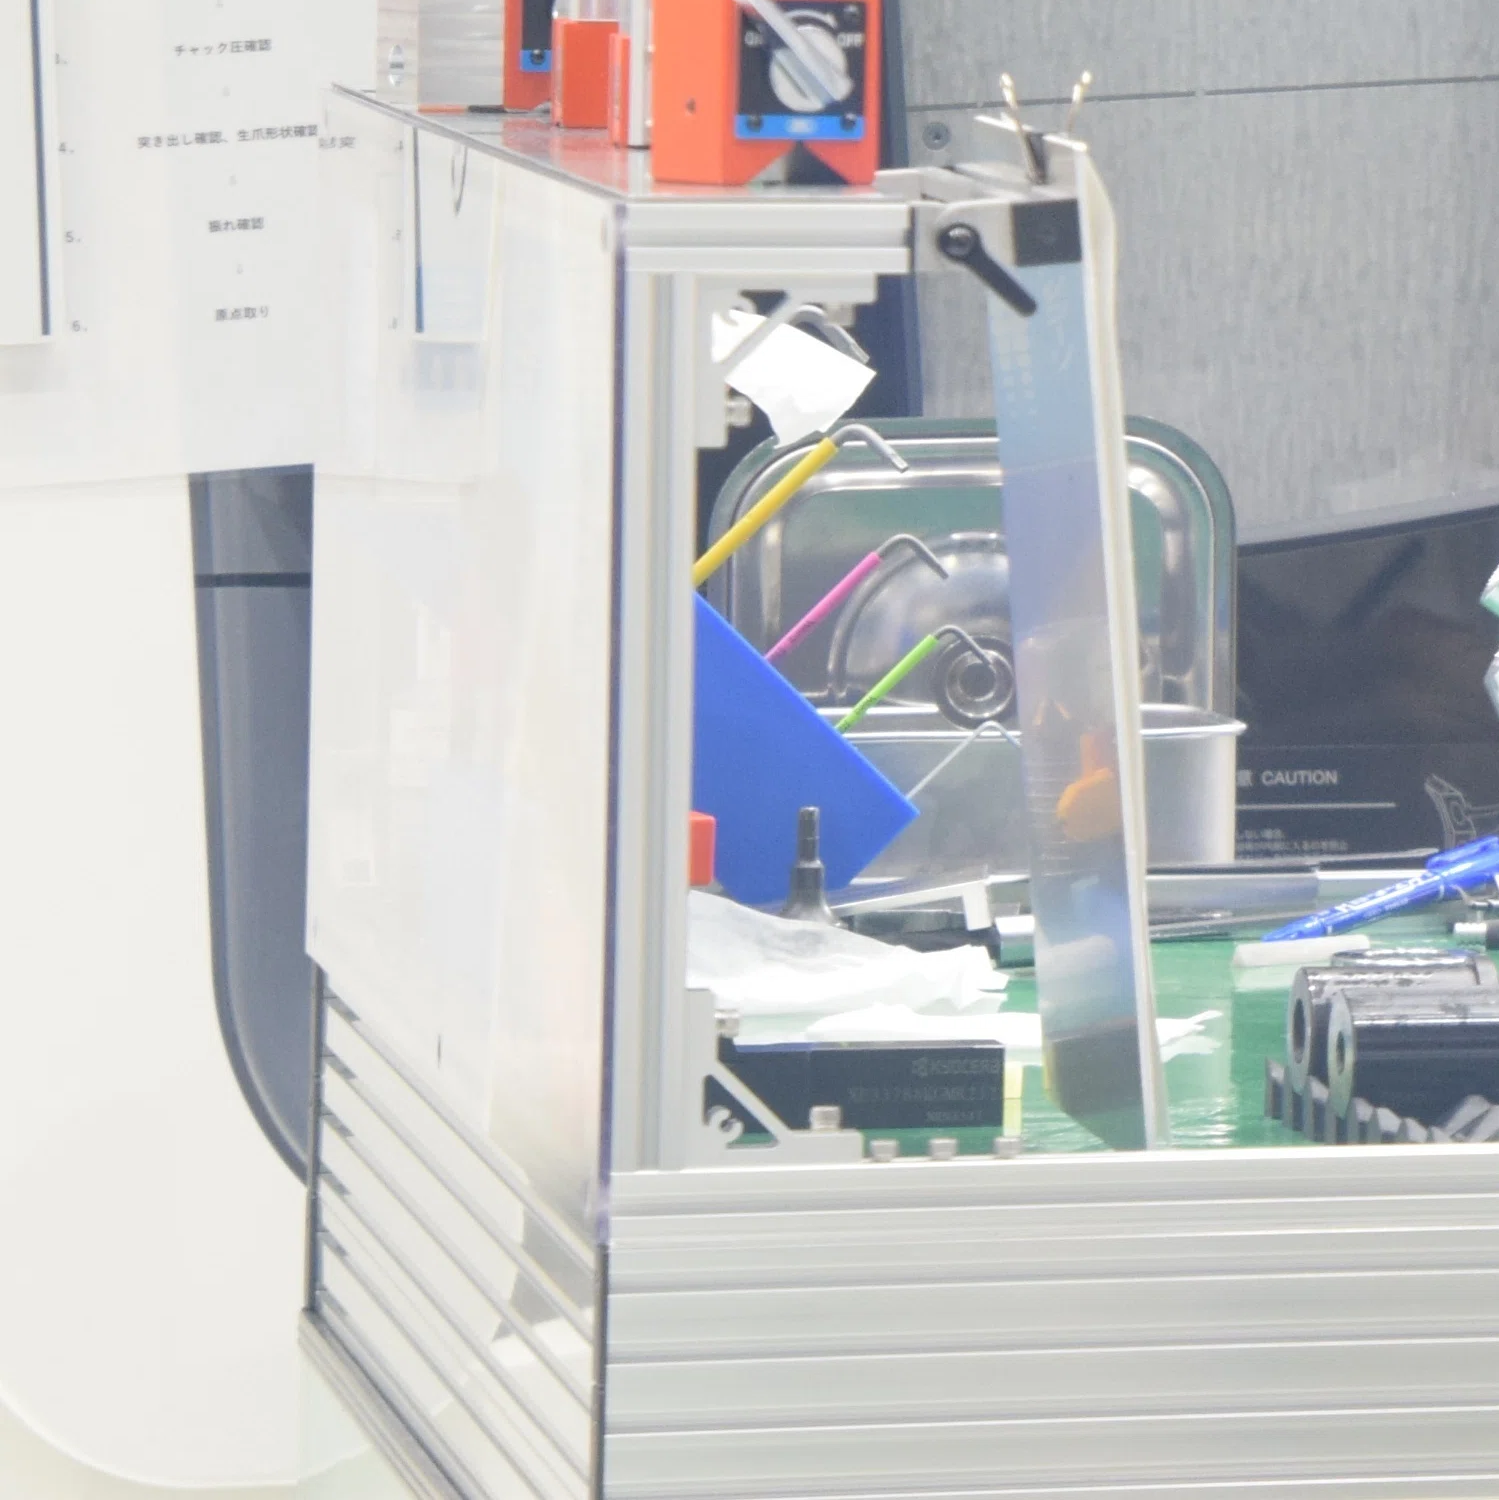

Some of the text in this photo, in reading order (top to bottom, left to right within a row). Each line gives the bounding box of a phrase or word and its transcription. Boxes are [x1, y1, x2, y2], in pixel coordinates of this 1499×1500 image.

[174, 39, 272, 57] チャック圧確認
[209, 216, 265, 234] 振れ確認
[1261, 769, 1339, 786] CAUTION
